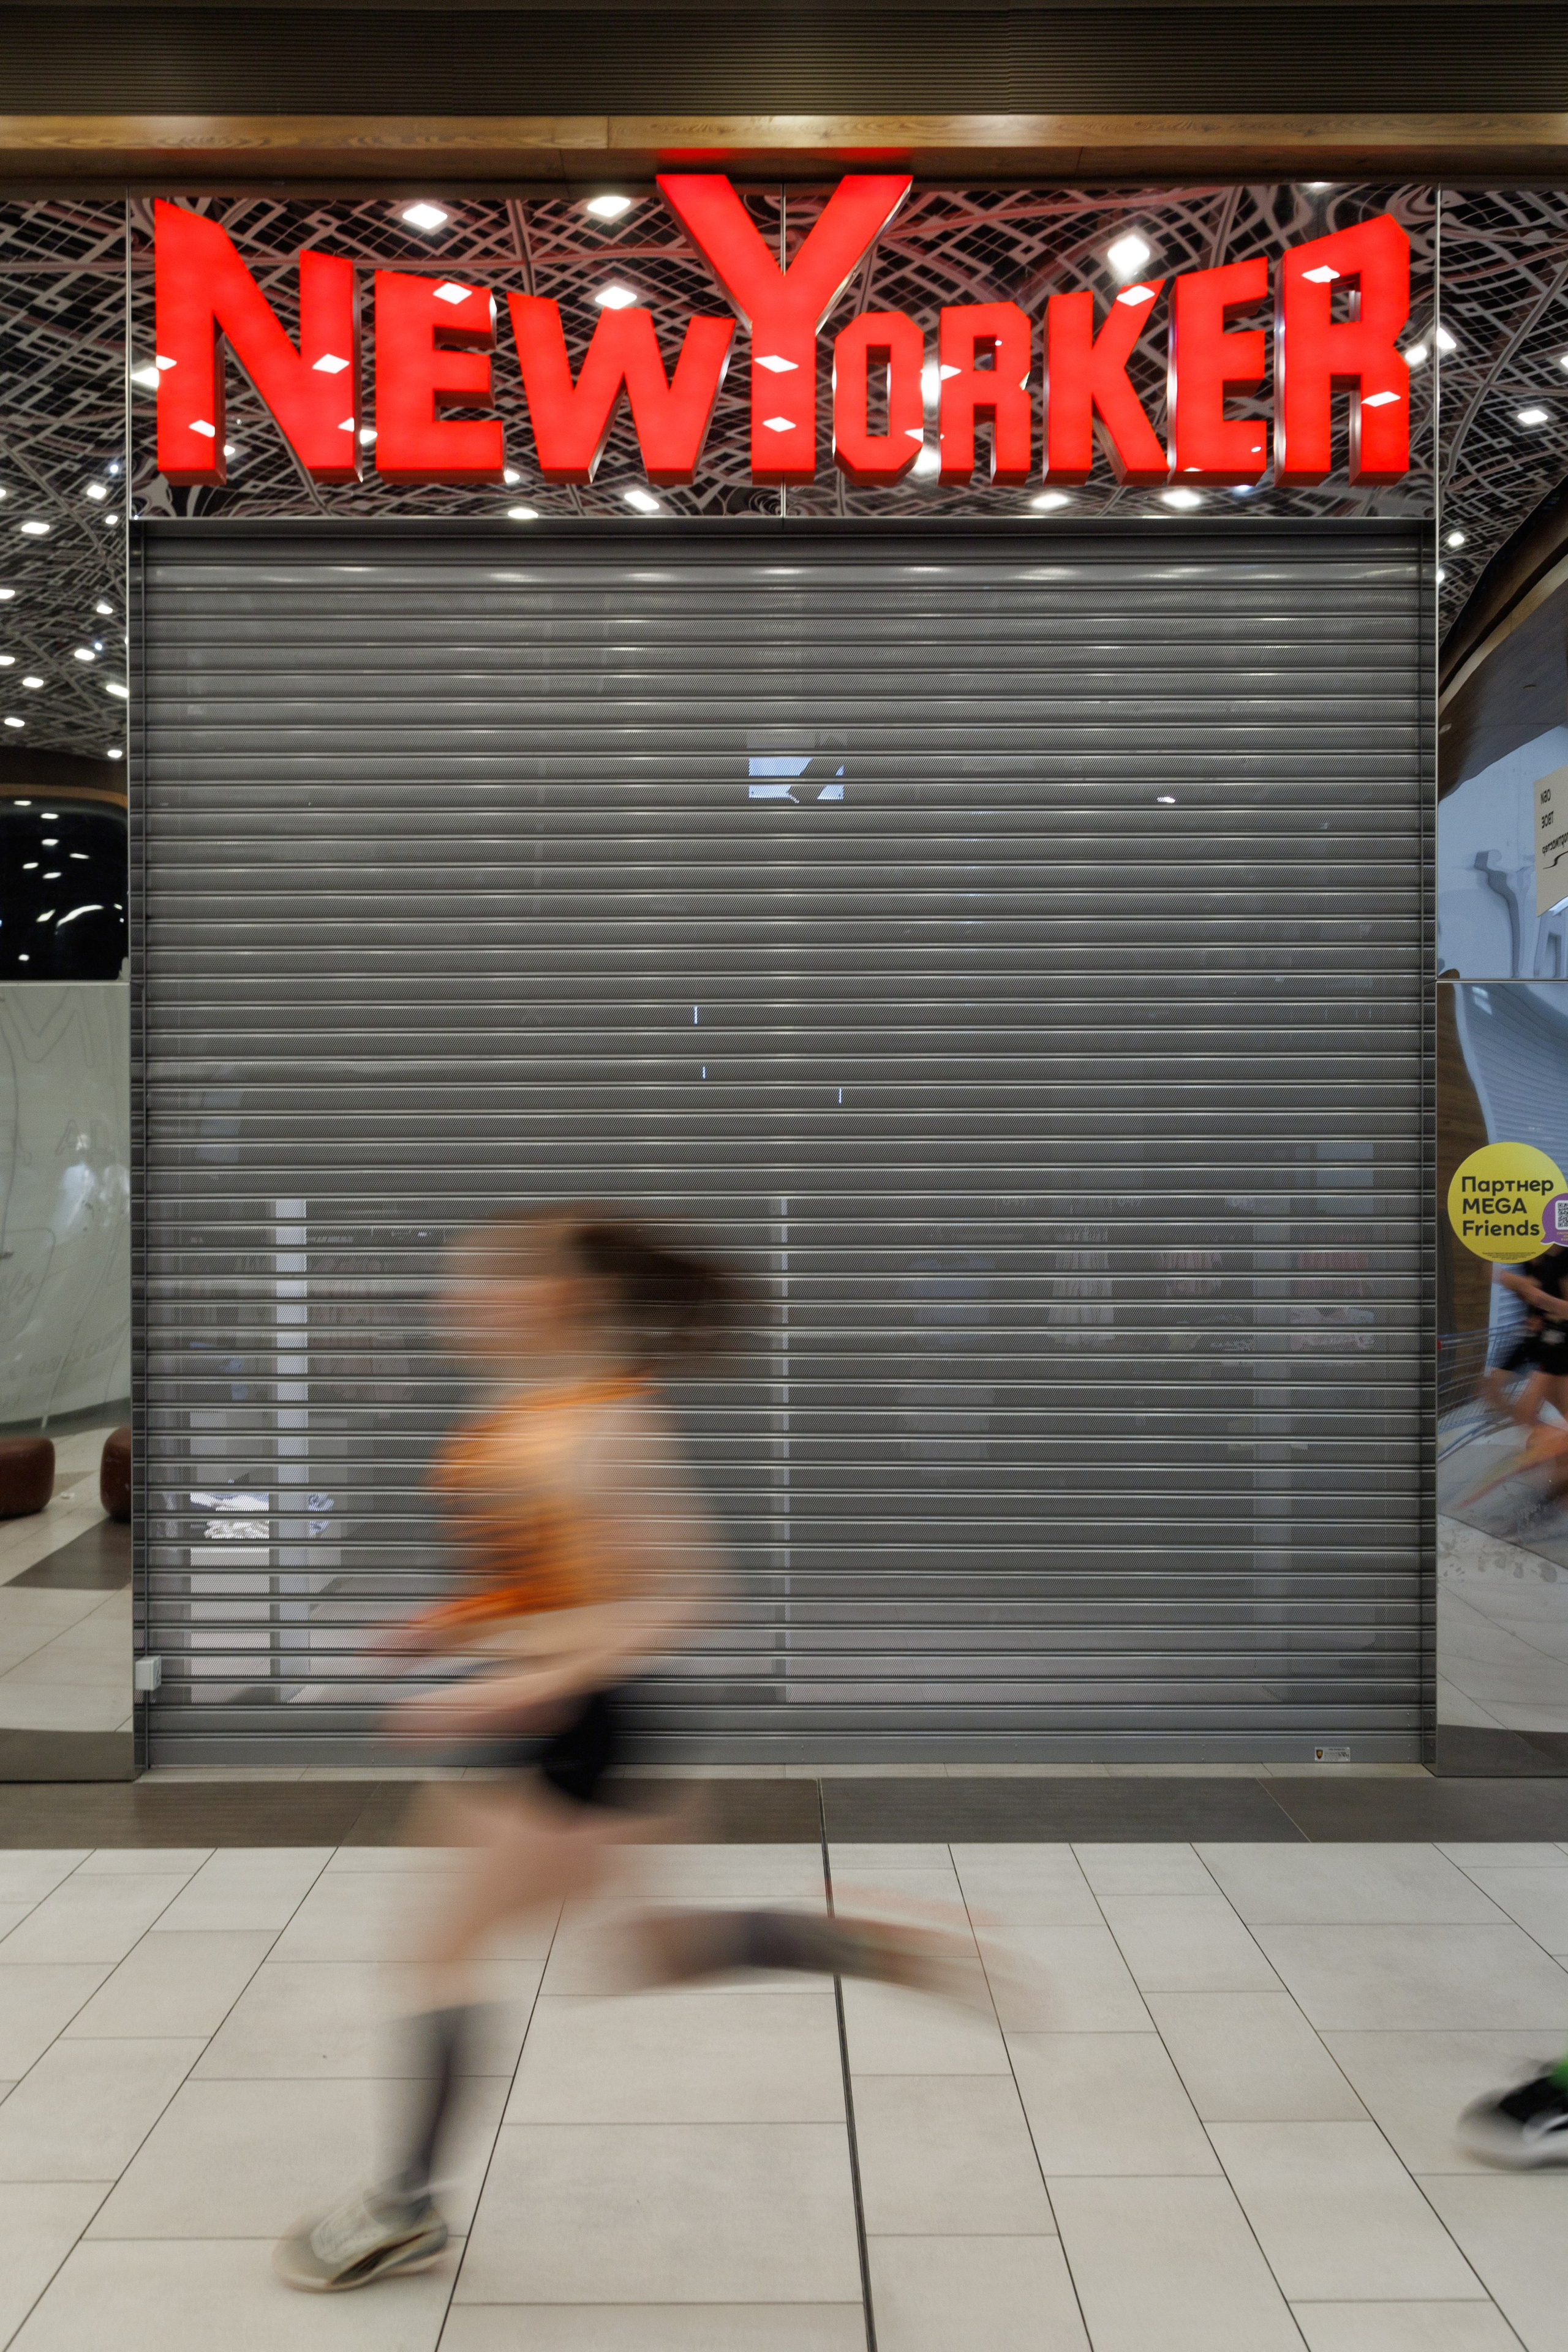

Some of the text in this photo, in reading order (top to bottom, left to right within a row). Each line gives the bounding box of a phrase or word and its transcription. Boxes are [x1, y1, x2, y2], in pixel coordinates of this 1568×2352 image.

[1461, 1176, 1554, 1196] Партнер
[1462, 1197, 1528, 1215] MEGA
[1463, 1219, 1540, 1237] Friends
